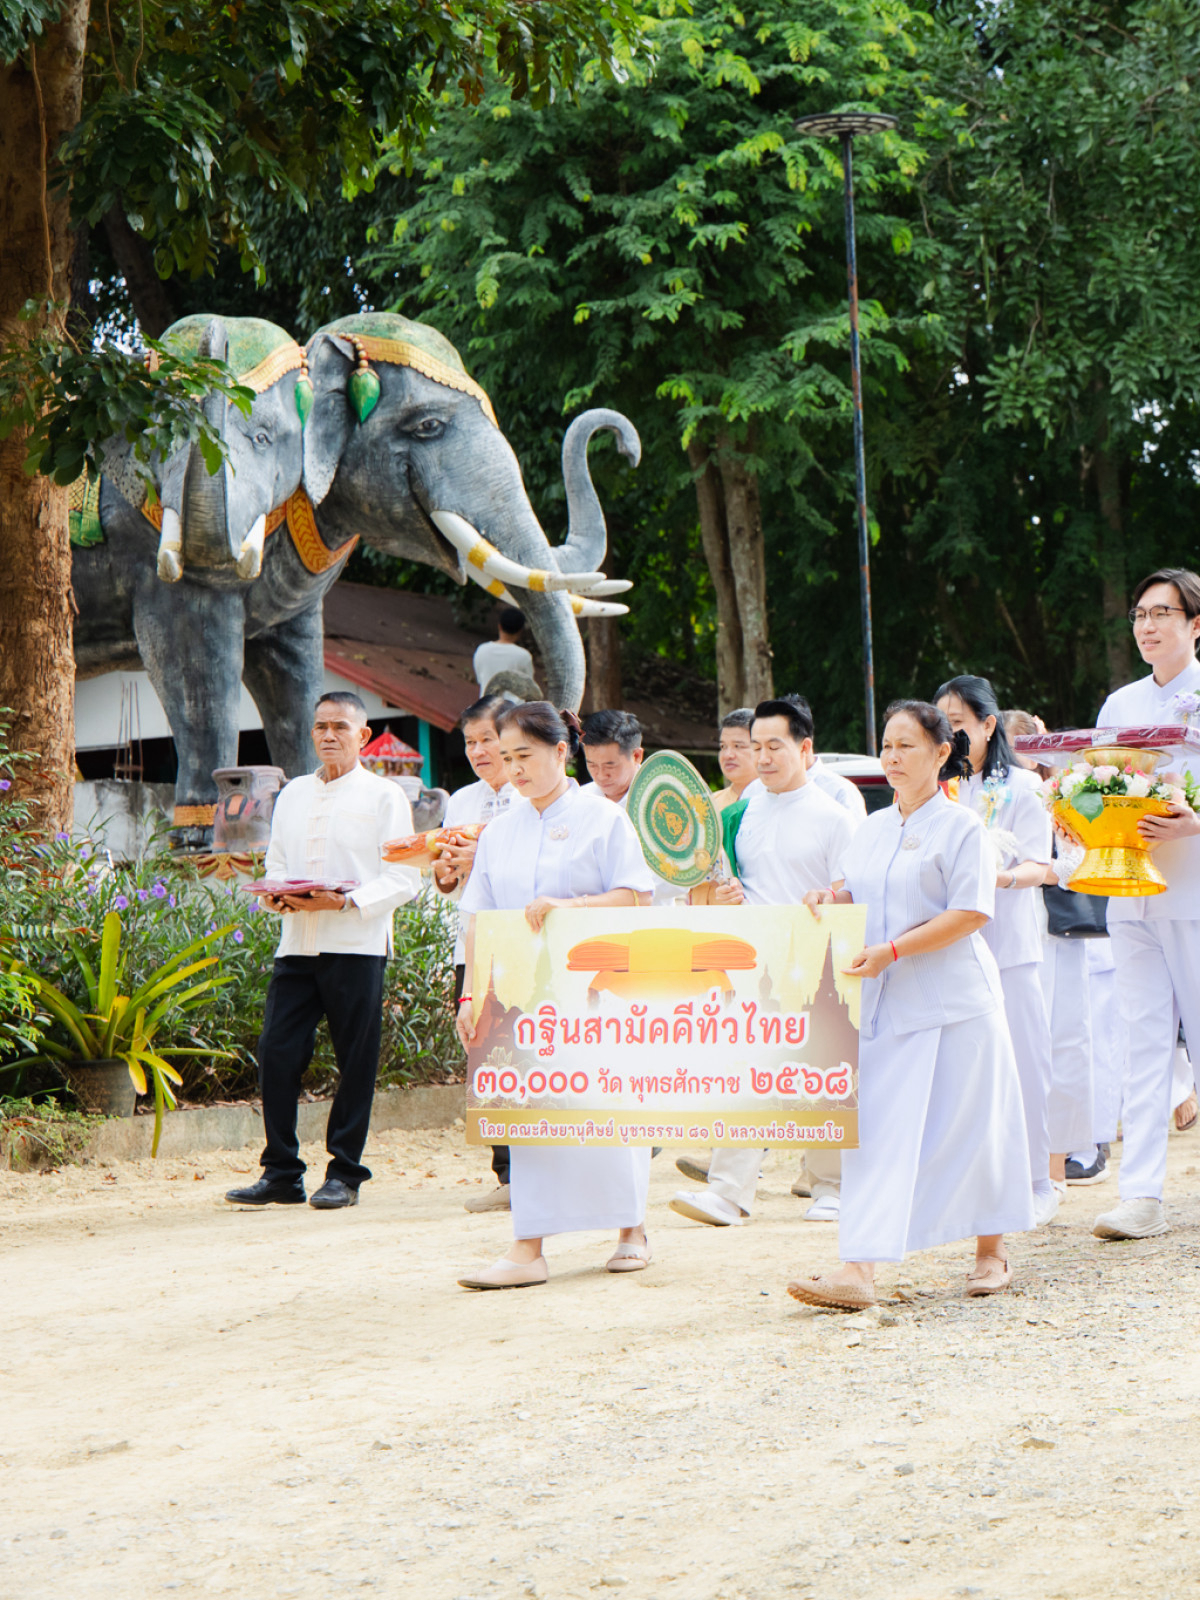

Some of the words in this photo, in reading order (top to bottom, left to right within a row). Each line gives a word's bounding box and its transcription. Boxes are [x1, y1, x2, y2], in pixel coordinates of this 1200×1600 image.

[517, 991, 806, 1057] กฐินสามัคคีทั่วไทย
[477, 1070, 589, 1098] ๓๐,๐๐๐
[597, 1068, 622, 1094] วัด
[629, 1068, 740, 1102] พุทธศักราช
[750, 1066, 849, 1095] ๒๕๖๘
[479, 1119, 505, 1137] โดย
[510, 1119, 614, 1142] คณะศิษยานุศิษย์
[619, 1125, 684, 1143] บูชาธรรม
[714, 1121, 725, 1138] ปี
